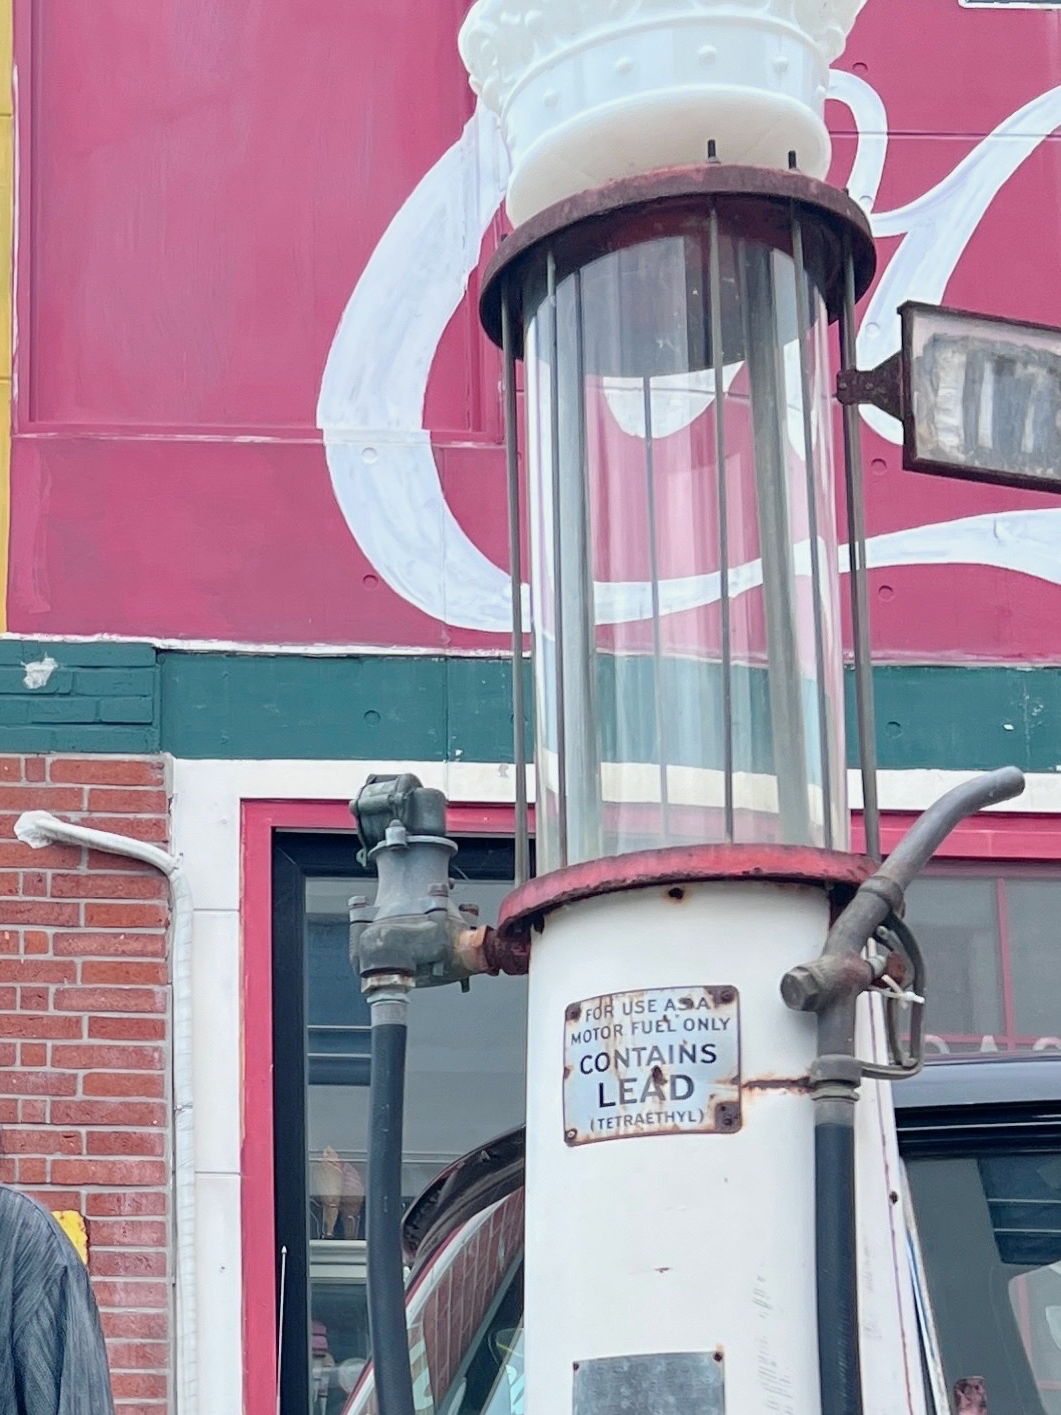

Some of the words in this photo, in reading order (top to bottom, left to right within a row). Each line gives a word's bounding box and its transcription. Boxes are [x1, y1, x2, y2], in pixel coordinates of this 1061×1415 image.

[586, 1005, 614, 1022] FOR
[622, 1000, 657, 1016] USE
[696, 997, 711, 1010] A
[571, 1024, 623, 1045] MOTOR
[631, 1020, 677, 1036] FUEL
[683, 1017, 731, 1032] ONLY
[580, 1043, 717, 1075] CONTAINS
[598, 1074, 694, 1108] LEAD
[590, 1108, 705, 1132] (TETRAETHYL)
